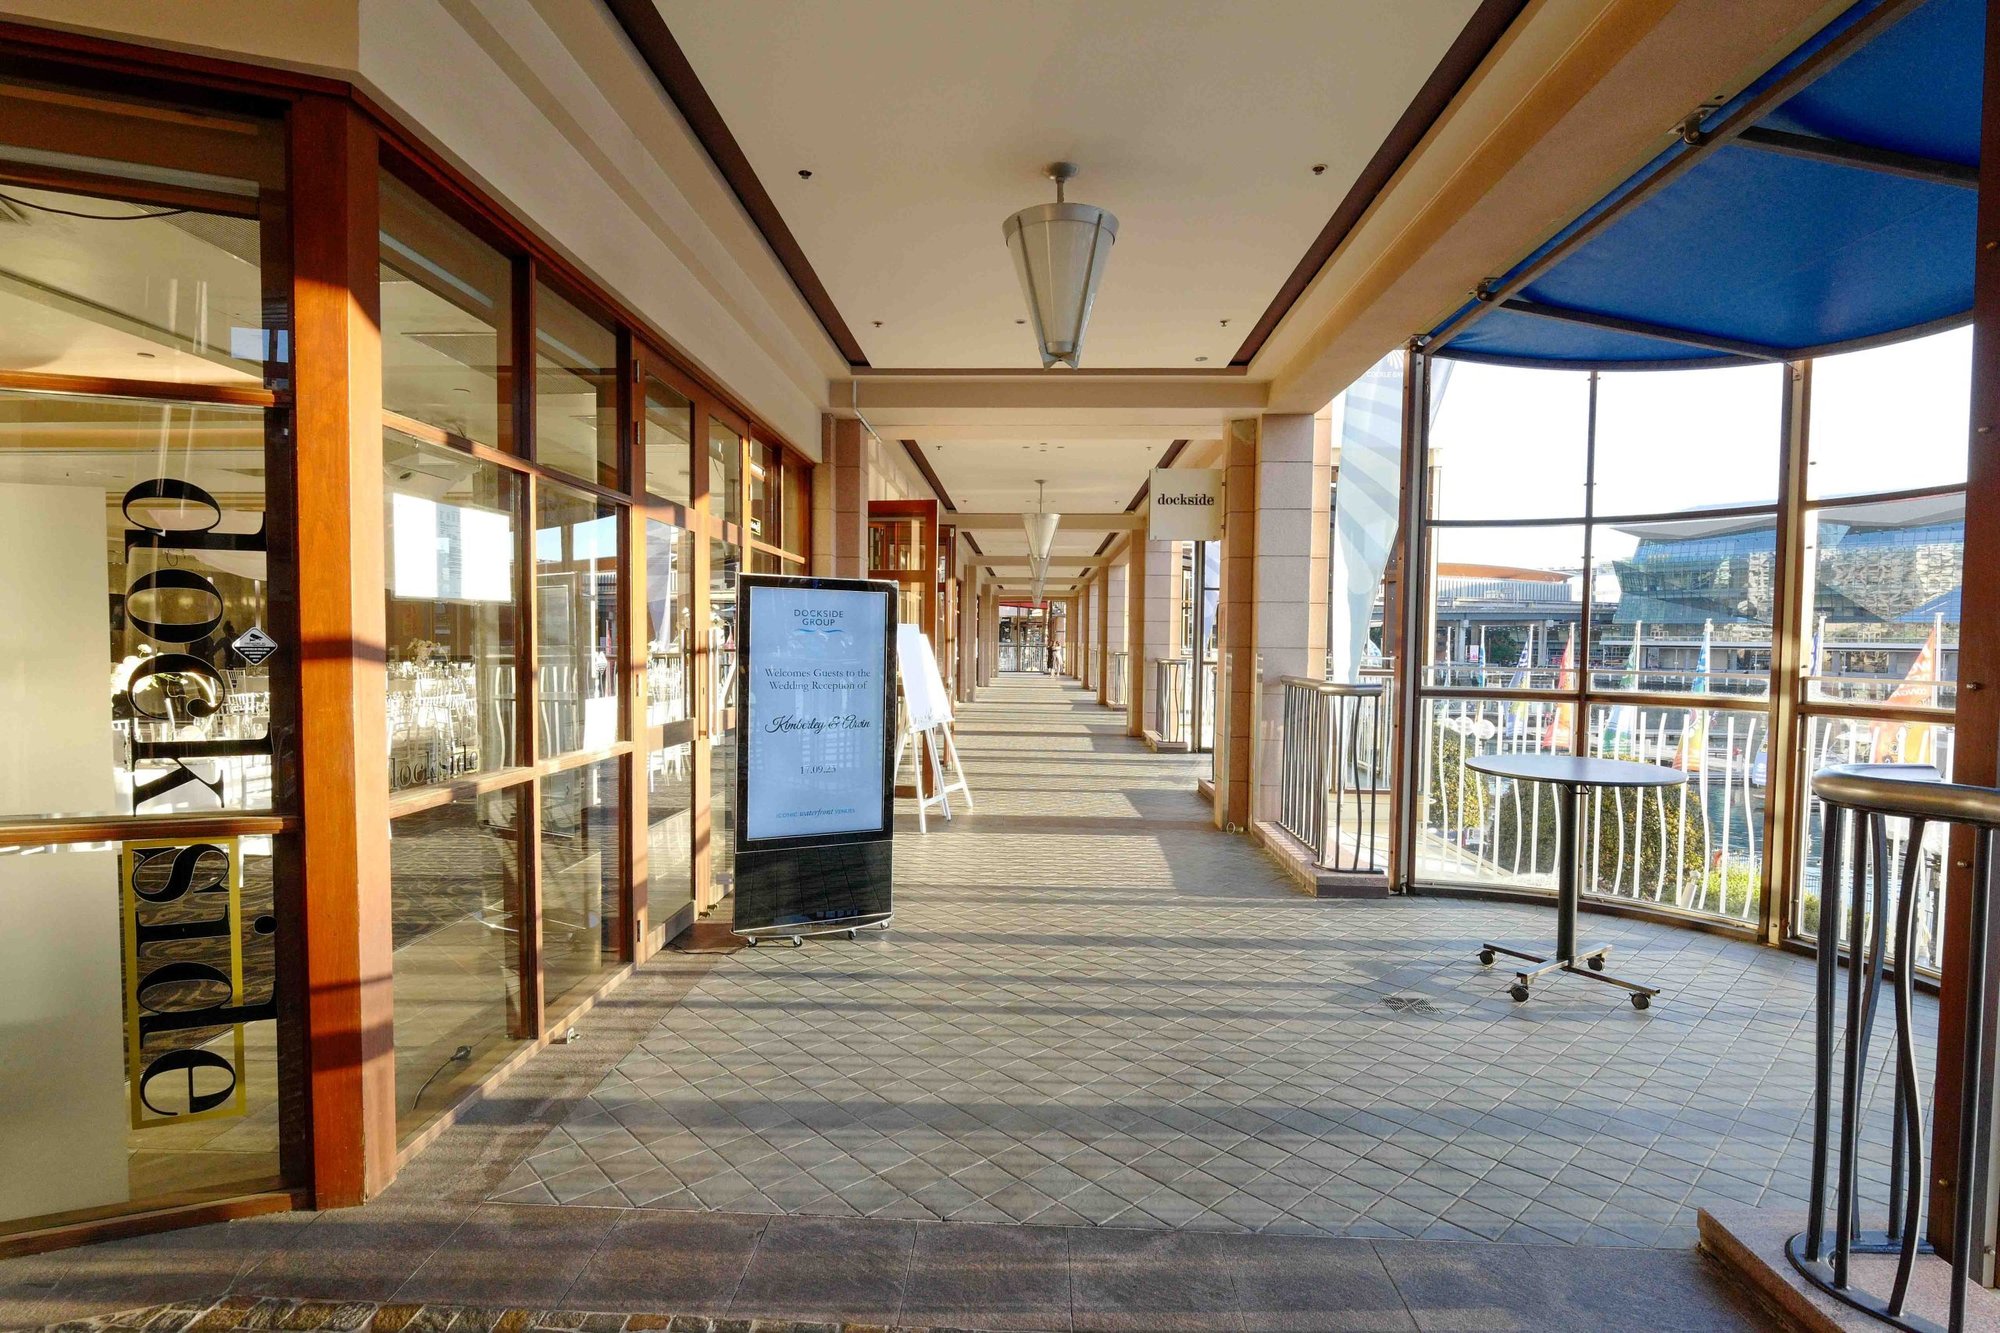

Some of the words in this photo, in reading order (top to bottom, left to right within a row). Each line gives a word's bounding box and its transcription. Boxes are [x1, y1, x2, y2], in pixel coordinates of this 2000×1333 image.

[1157, 493, 1215, 506] dockside
[793, 609, 844, 618] DOCKSIDE
[801, 618, 836, 626] GROUP
[765, 668, 811, 677] Welcomes
[813, 668, 844, 677] Guests
[846, 669, 855, 677] to
[857, 668, 871, 677] the
[769, 681, 809, 692] Wedding
[812, 681, 855, 692] Reception
[857, 681, 868, 690] of
[765, 714, 826, 734] Kimberley
[122, 478, 277, 1116] dockside
